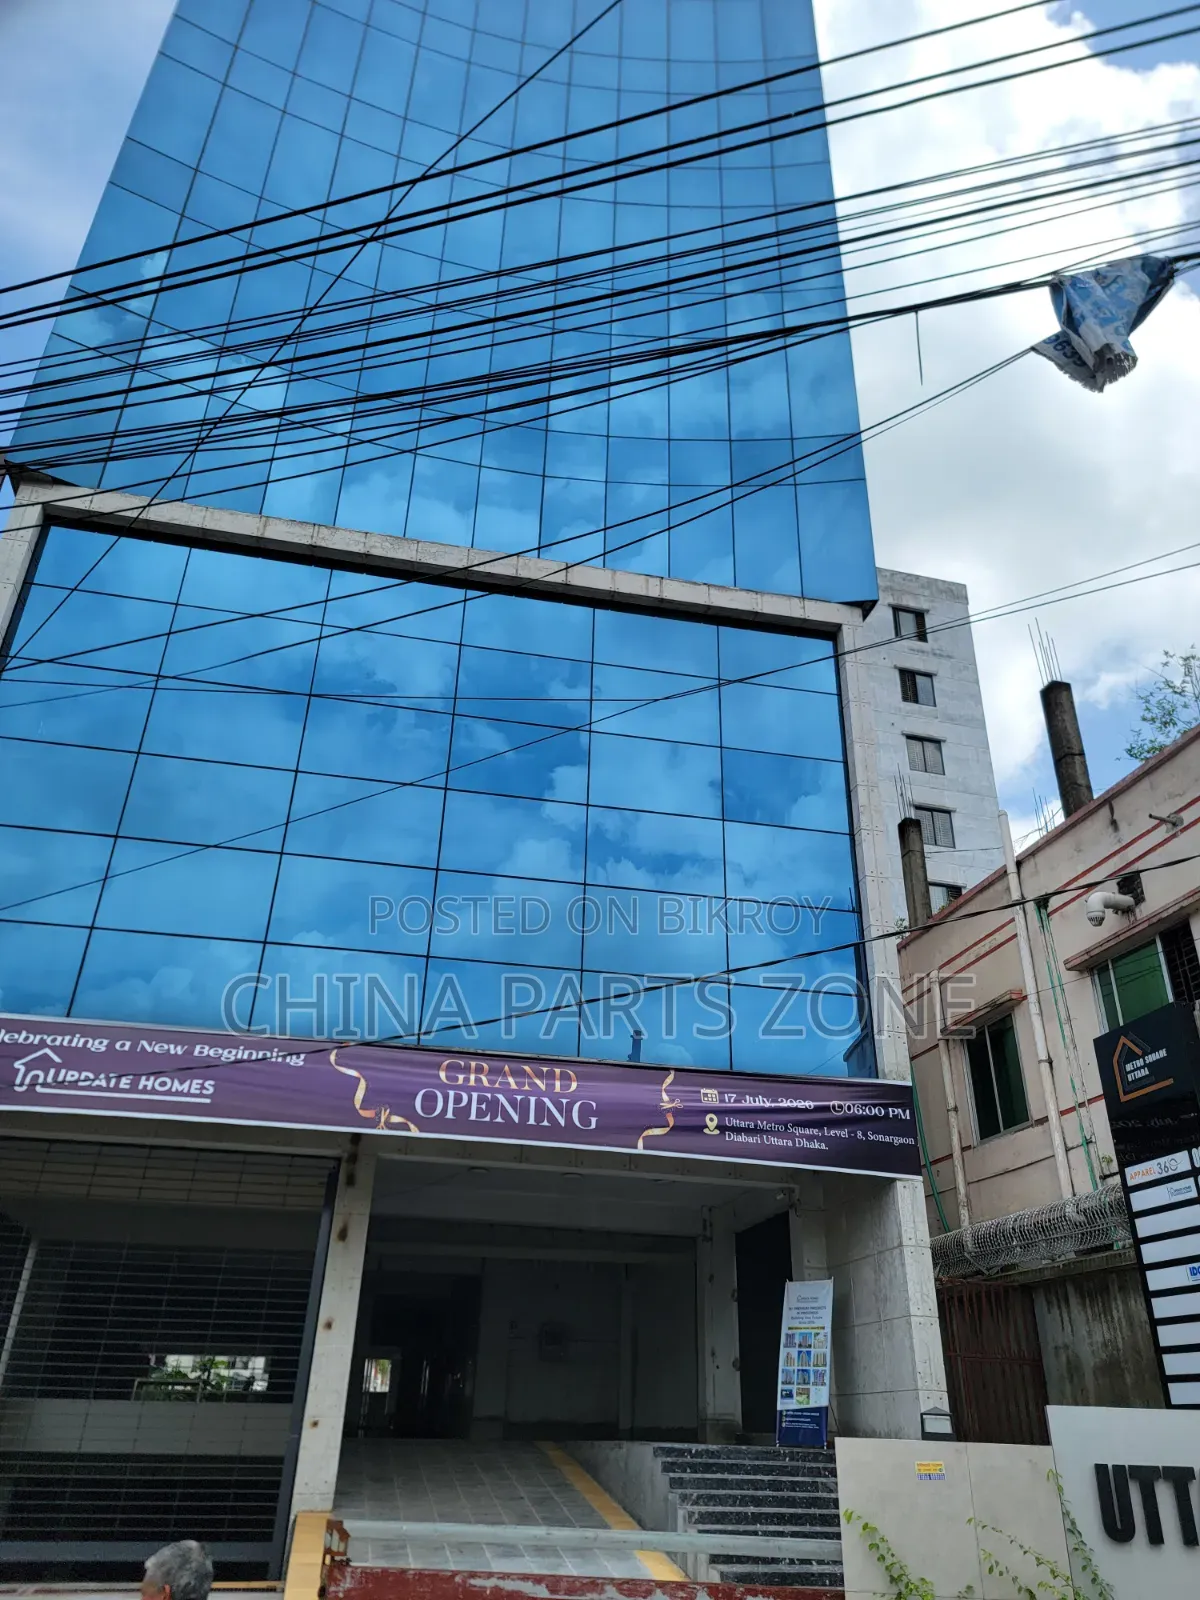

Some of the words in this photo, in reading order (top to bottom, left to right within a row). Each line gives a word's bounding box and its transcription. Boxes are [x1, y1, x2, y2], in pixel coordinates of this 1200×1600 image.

[115, 1040, 132, 1052] a
[137, 1040, 188, 1056] New
[193, 1044, 305, 1066] Beginning
[1125, 1057, 1145, 1072] METRO
[46, 1067, 134, 1090] UPDATE
[138, 1076, 216, 1095] HOMES
[438, 1058, 578, 1094] GRAND
[1127, 1067, 1150, 1082] UTTARA
[414, 1088, 599, 1130] OPENING
[724, 1093, 737, 1103] 17
[844, 1102, 885, 1117] 06:00
[888, 1107, 911, 1120] PM
[724, 1116, 755, 1129] Uttara
[757, 1119, 785, 1132] Metro
[787, 1122, 822, 1137] Square,
[824, 1126, 849, 1138] Level
[867, 1130, 915, 1146] Sonargaon
[725, 1131, 761, 1144] Diabari
[763, 1134, 793, 1147] Uttara
[795, 1137, 829, 1151] Dhaka.
[1129, 1166, 1156, 1181] APPAREL
[1094, 1463, 1199, 1547] UTT
